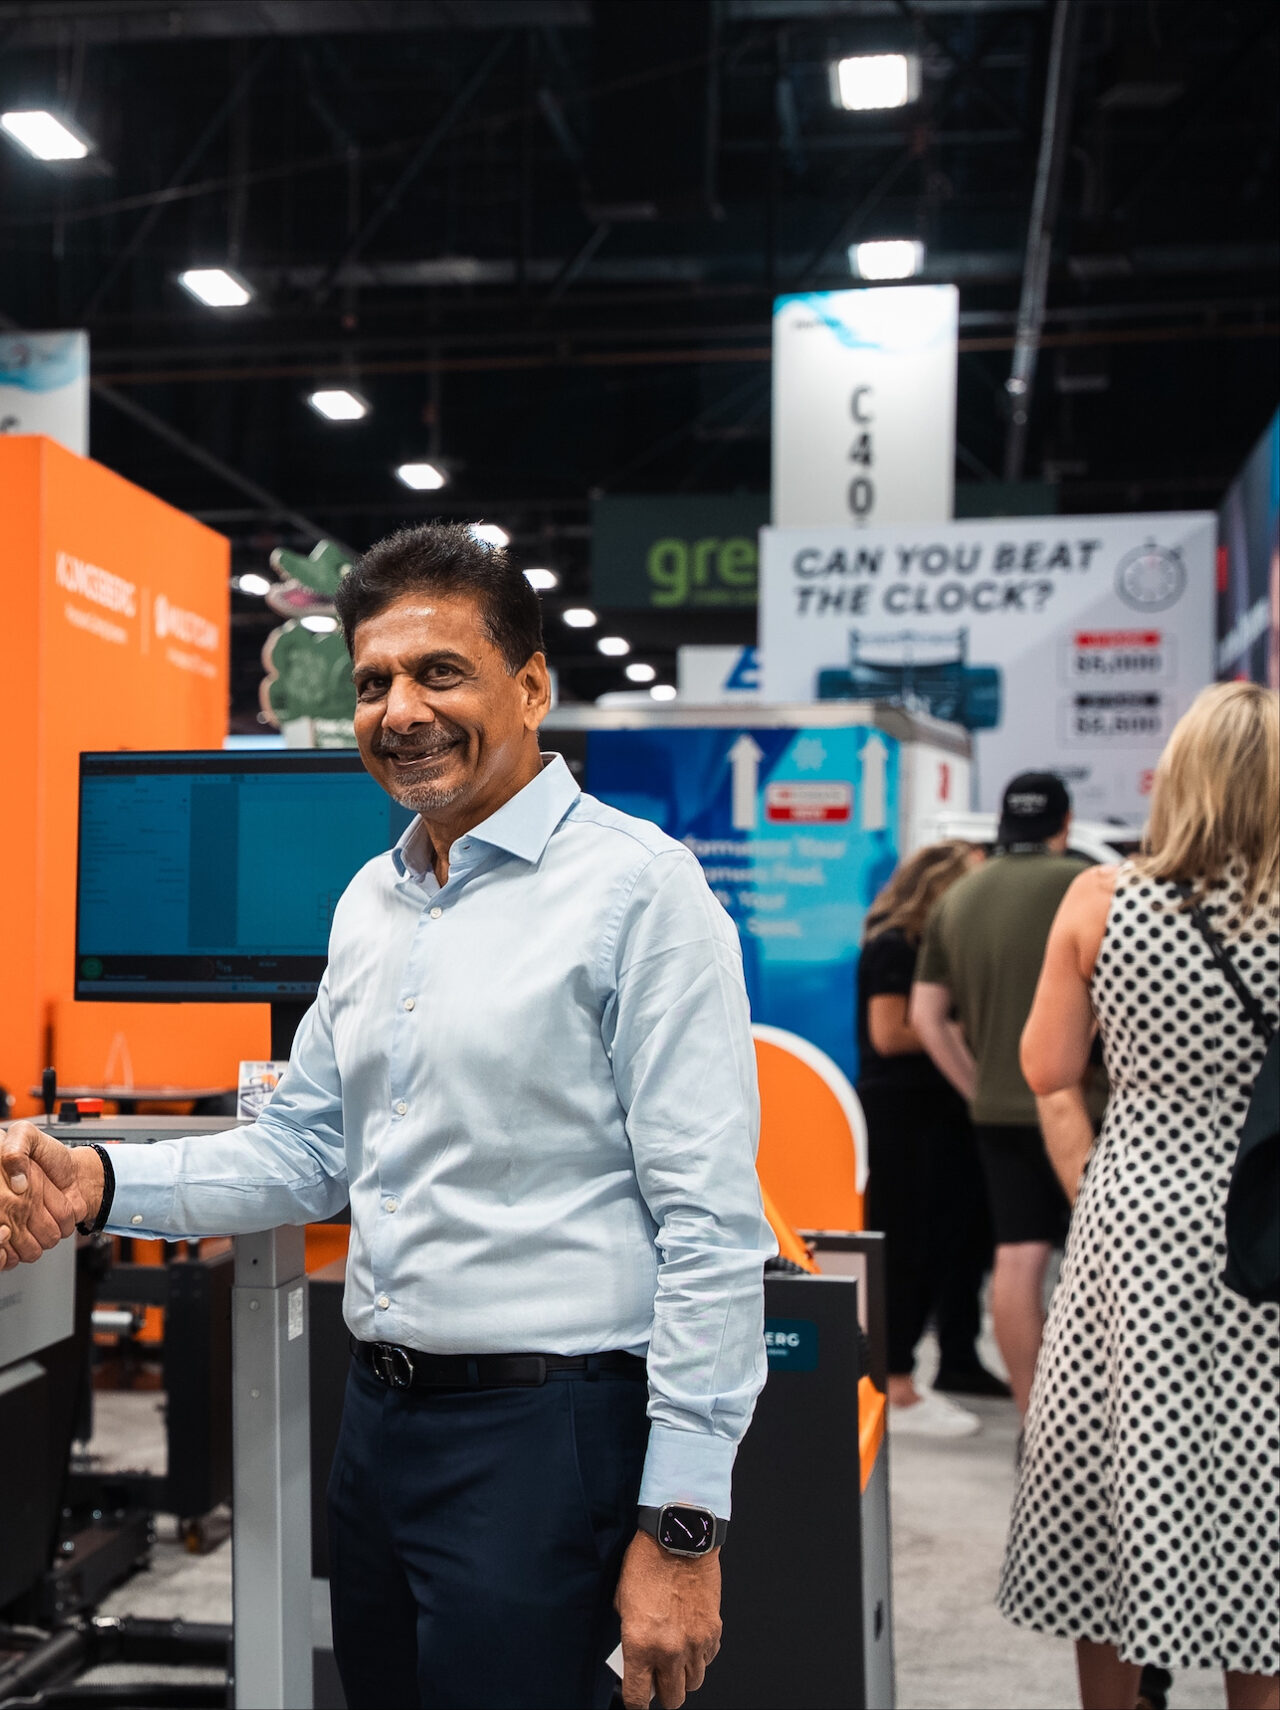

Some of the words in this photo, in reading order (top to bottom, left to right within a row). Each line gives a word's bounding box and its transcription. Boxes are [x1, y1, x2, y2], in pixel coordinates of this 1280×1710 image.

[847, 384, 875, 527] C40
[793, 547, 882, 579] CAN
[896, 543, 981, 577] YOU
[991, 539, 1101, 575] BEAT
[795, 585, 870, 617] THE
[882, 580, 1055, 616] CLOCK?
